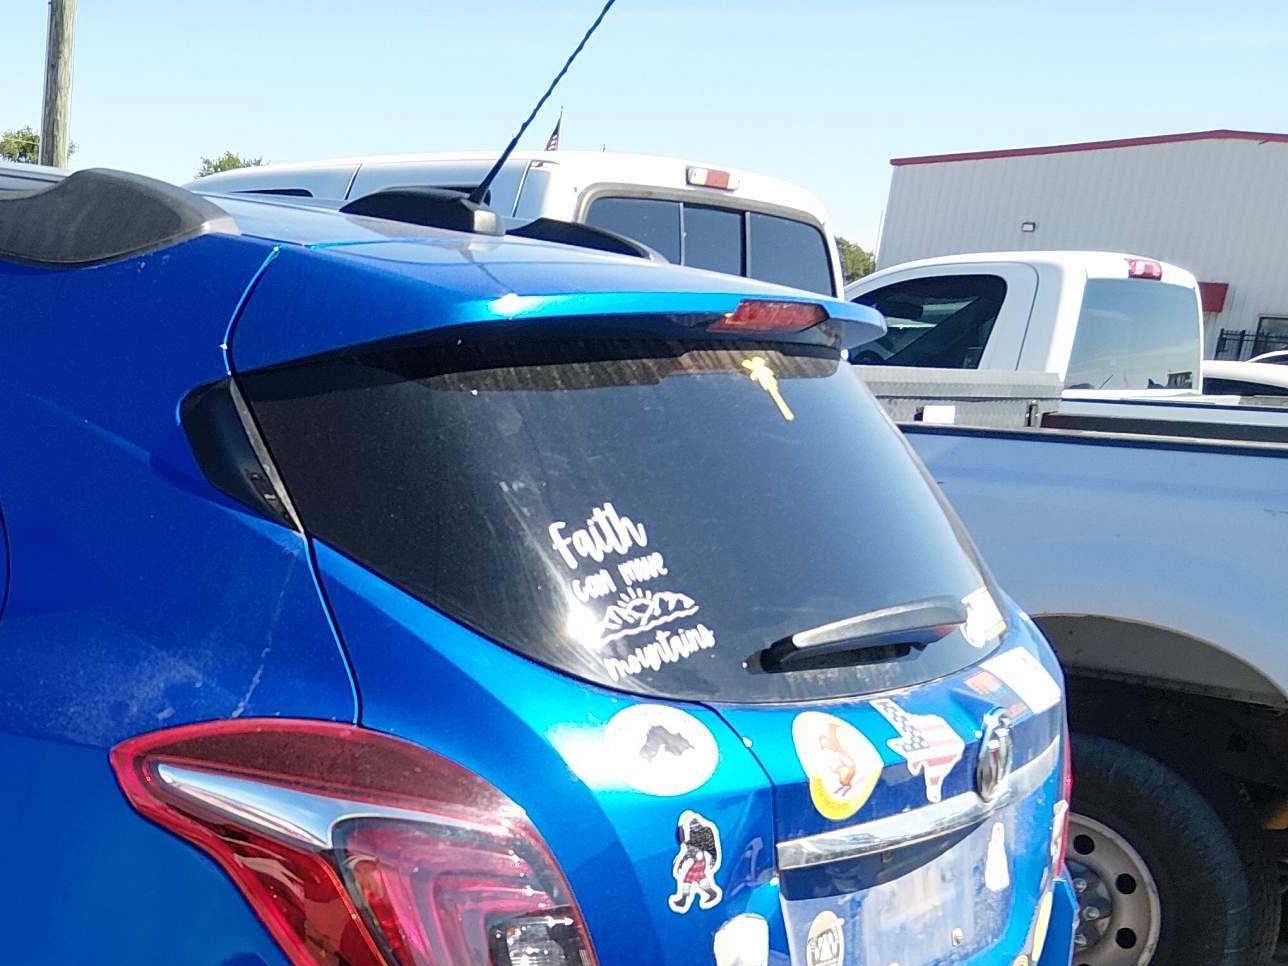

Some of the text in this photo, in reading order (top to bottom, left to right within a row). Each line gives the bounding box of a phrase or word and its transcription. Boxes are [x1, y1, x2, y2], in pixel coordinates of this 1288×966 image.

[548, 502, 648, 570] Faith
[572, 552, 668, 602] can move
[604, 624, 716, 682] mountains
